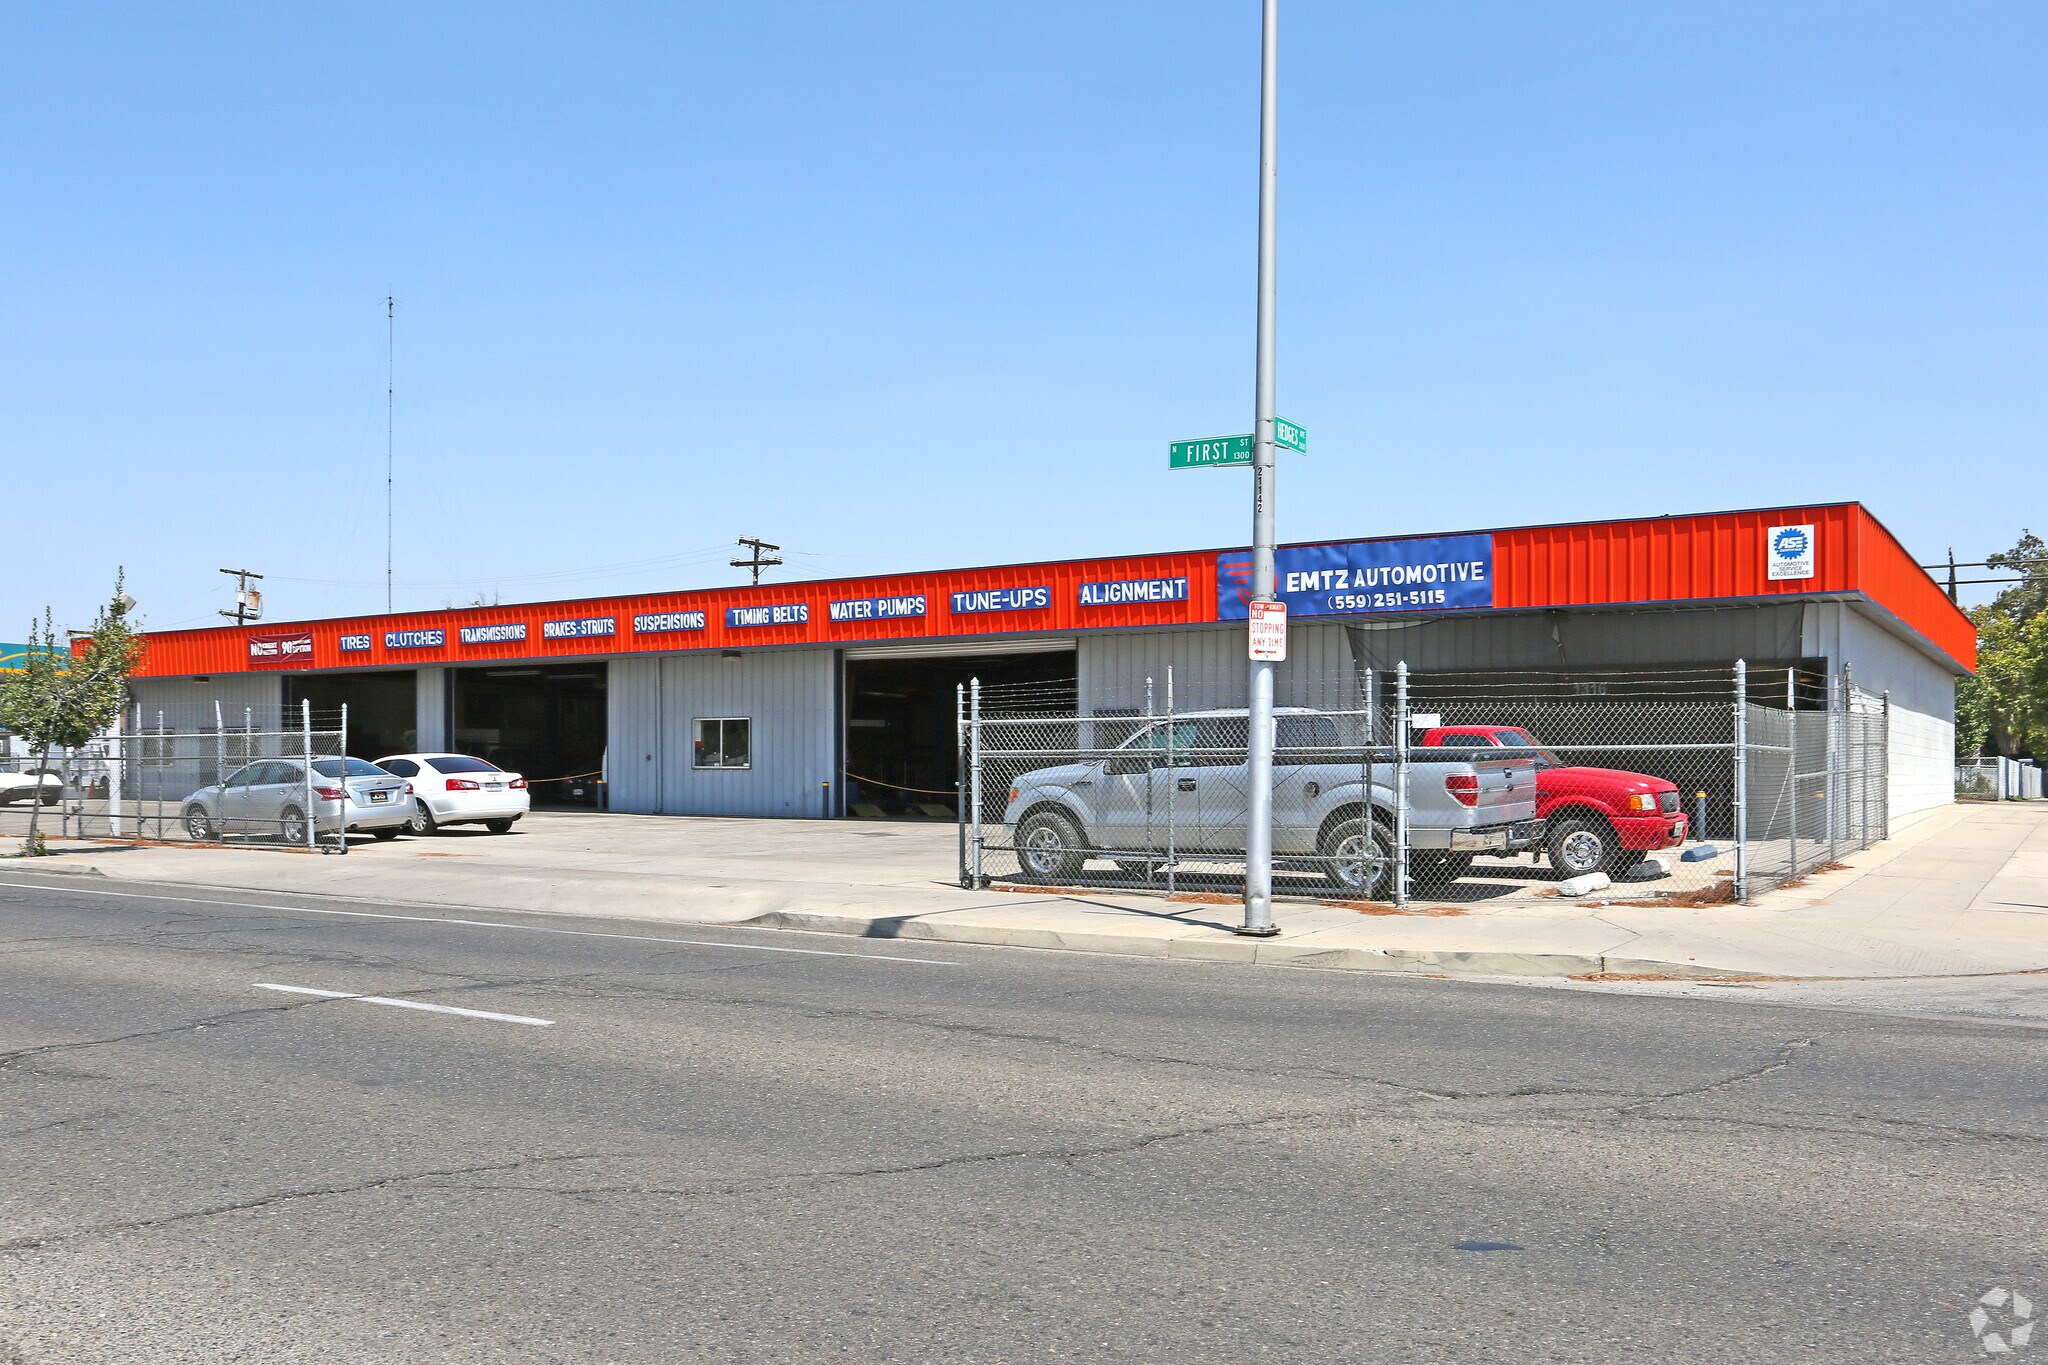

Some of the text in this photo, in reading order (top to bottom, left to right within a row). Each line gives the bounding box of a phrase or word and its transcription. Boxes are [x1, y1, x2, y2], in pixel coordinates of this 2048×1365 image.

[1277, 421, 1299, 446] HEDGES
[1172, 438, 1249, 463] N FIRST ST
[1233, 451, 1250, 460] 1300
[1778, 536, 1804, 549] ASE
[1286, 561, 1484, 593] EMTZ AUTOMOTIVE
[953, 588, 1048, 612] TUNE-UPS
[1080, 579, 1187, 604] ALIGNMENT
[733, 603, 808, 627] TIMING BELTS
[830, 595, 926, 620] WATER PUMPS
[1252, 610, 1263, 619] NO
[543, 618, 614, 637] BRAKES-STRUTS
[634, 612, 705, 632] SUSPENSIONS
[1252, 623, 1284, 634] STOPPING
[341, 635, 370, 649] TIRES
[385, 630, 443, 647] CLUTCHES
[460, 624, 526, 643] TRANSMISSIONS
[1252, 638, 1283, 647] ANY TIME
[250, 643, 263, 656] NO
[282, 641, 293, 654] 90
